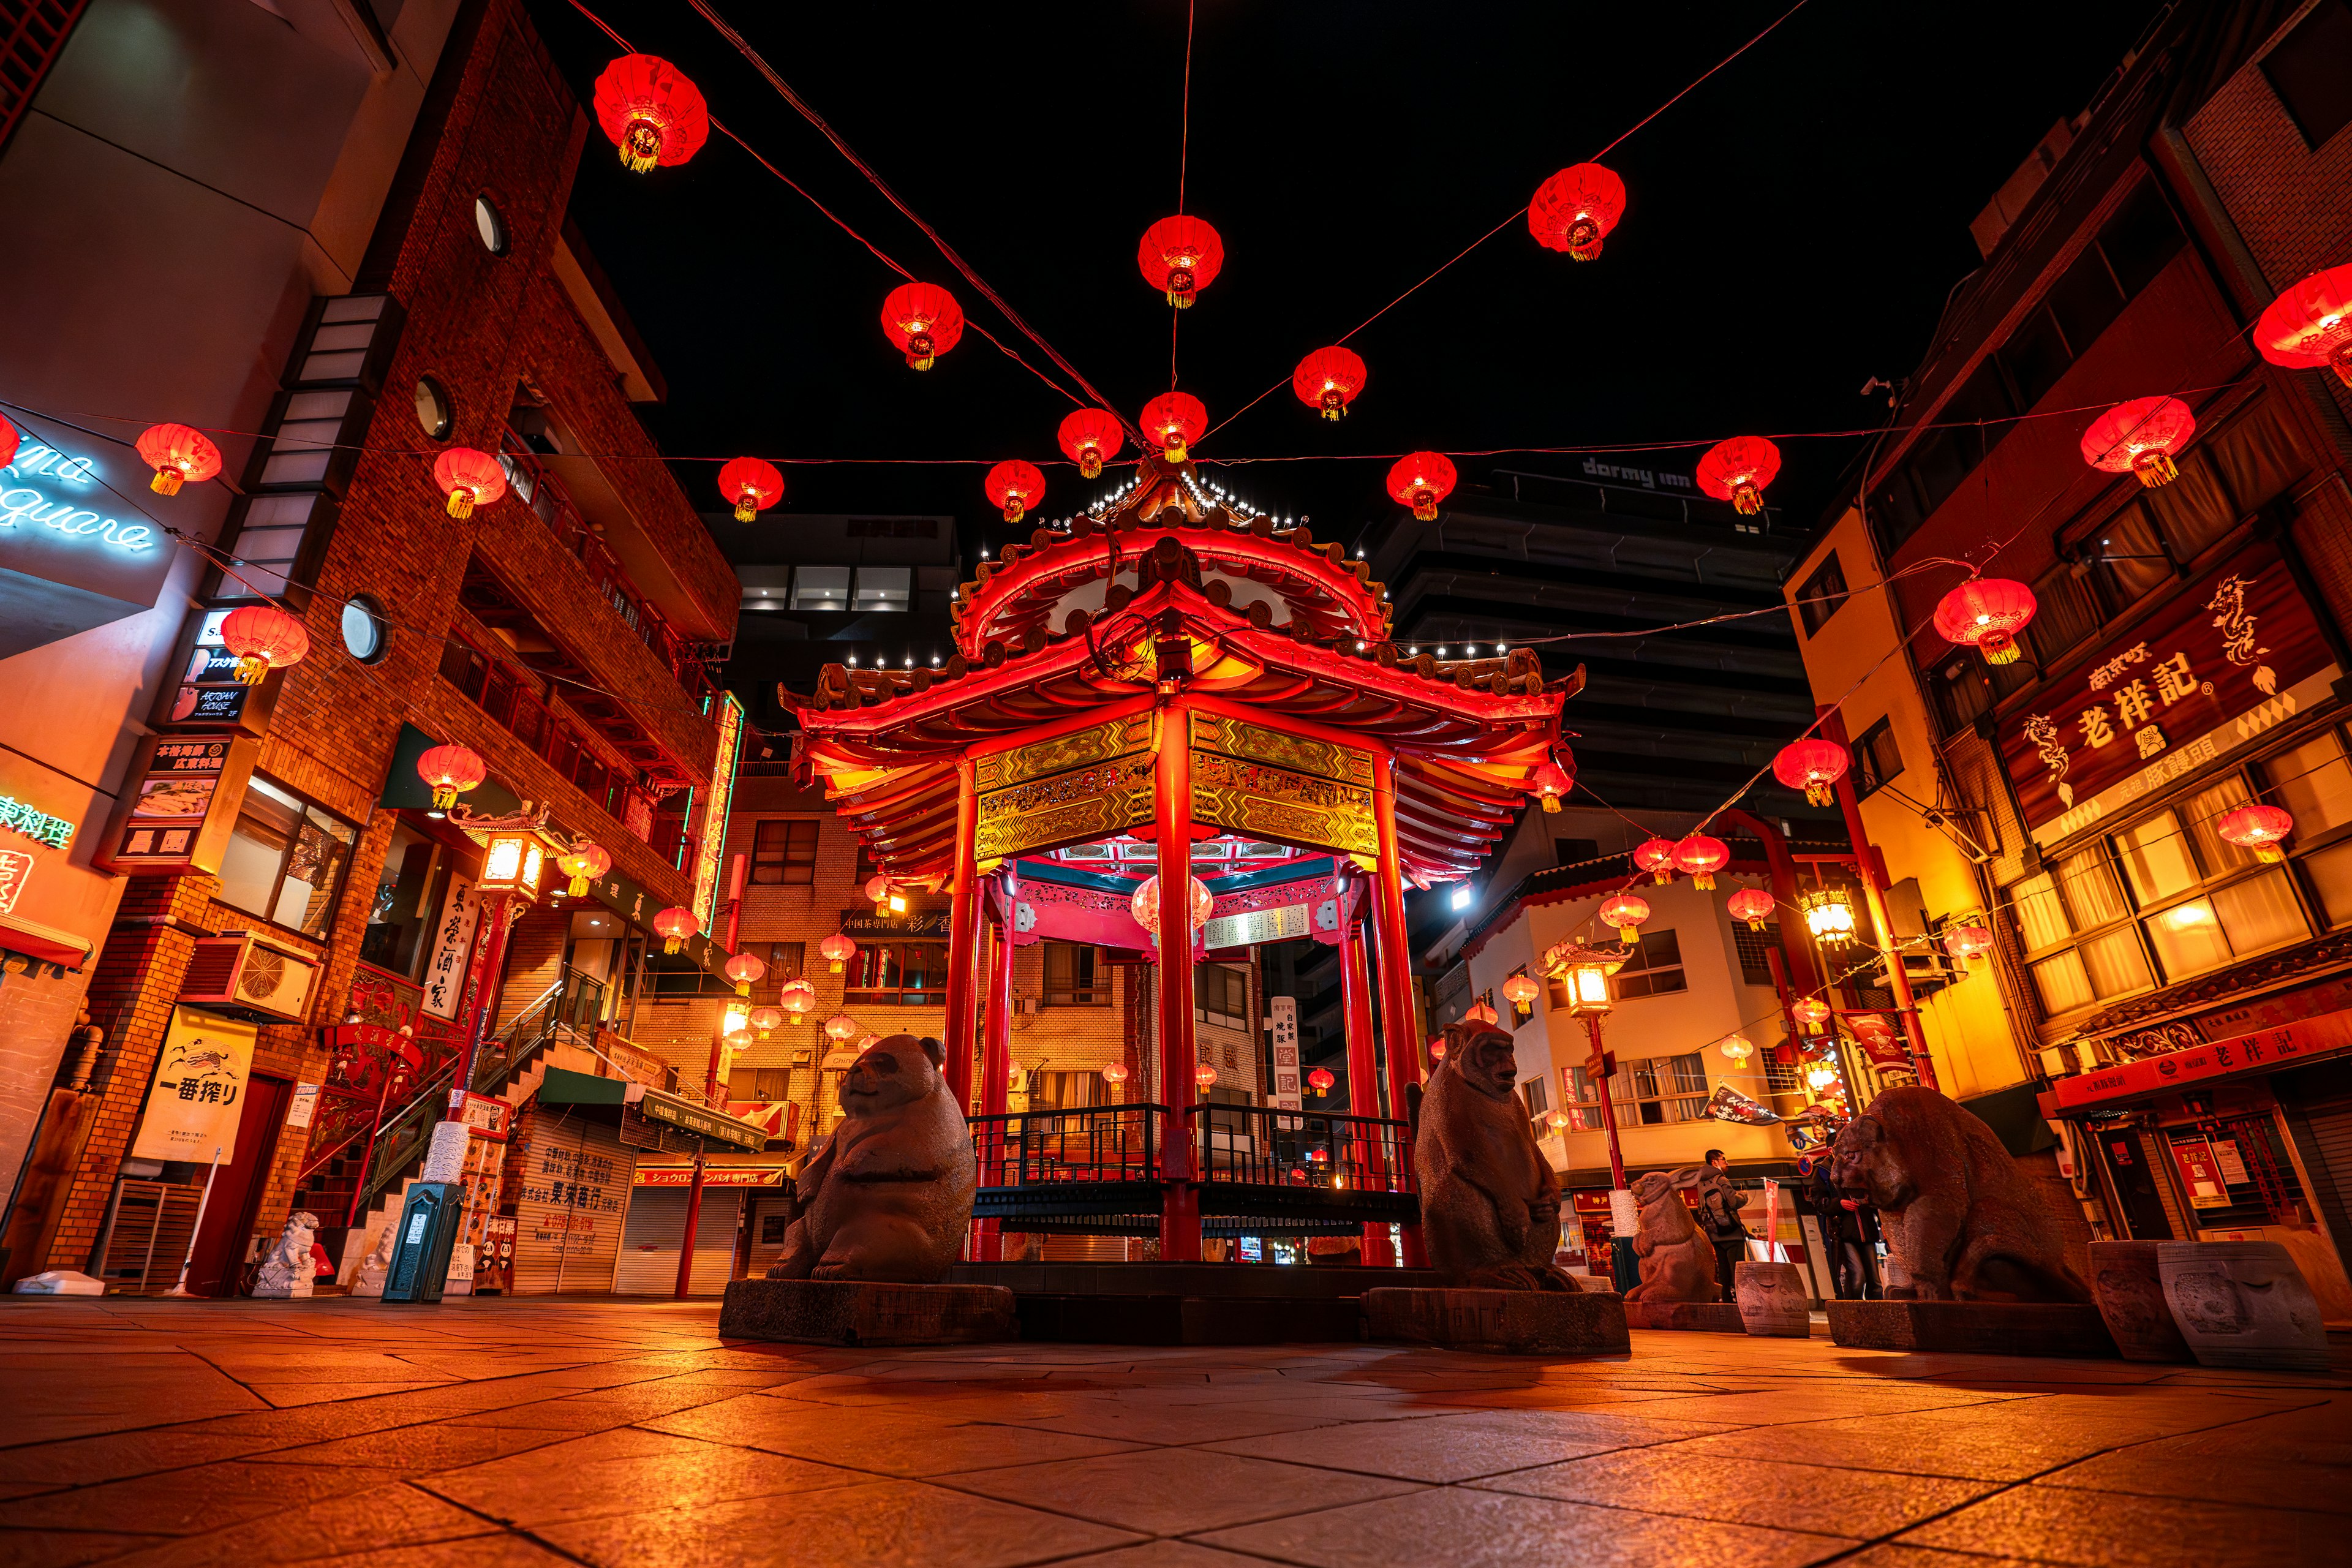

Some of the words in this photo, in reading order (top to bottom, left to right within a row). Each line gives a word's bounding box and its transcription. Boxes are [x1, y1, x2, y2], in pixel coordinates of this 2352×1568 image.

[1583, 457, 1655, 489] dormy
[1659, 472, 1691, 488] inn
[0, 488, 153, 548] quare
[2088, 641, 2152, 691] 南京町
[200, 691, 238, 701] ARTISAN
[202, 701, 232, 710] HOUSE
[2078, 652, 2199, 748] 老祥記
[173, 757, 223, 769] 広東料理
[2120, 778, 2144, 801] 元祖
[2144, 733, 2219, 791] 豚饅頭
[126, 830, 191, 853] 昌園
[845, 919, 898, 929] 中国茶専門店
[2212, 1030, 2297, 1068] 老祥記
[159, 1077, 237, 1106] 一番搾り
[635, 1172, 646, 1183] 包
[652, 1172, 758, 1183] ショウロンンパオ専門店
